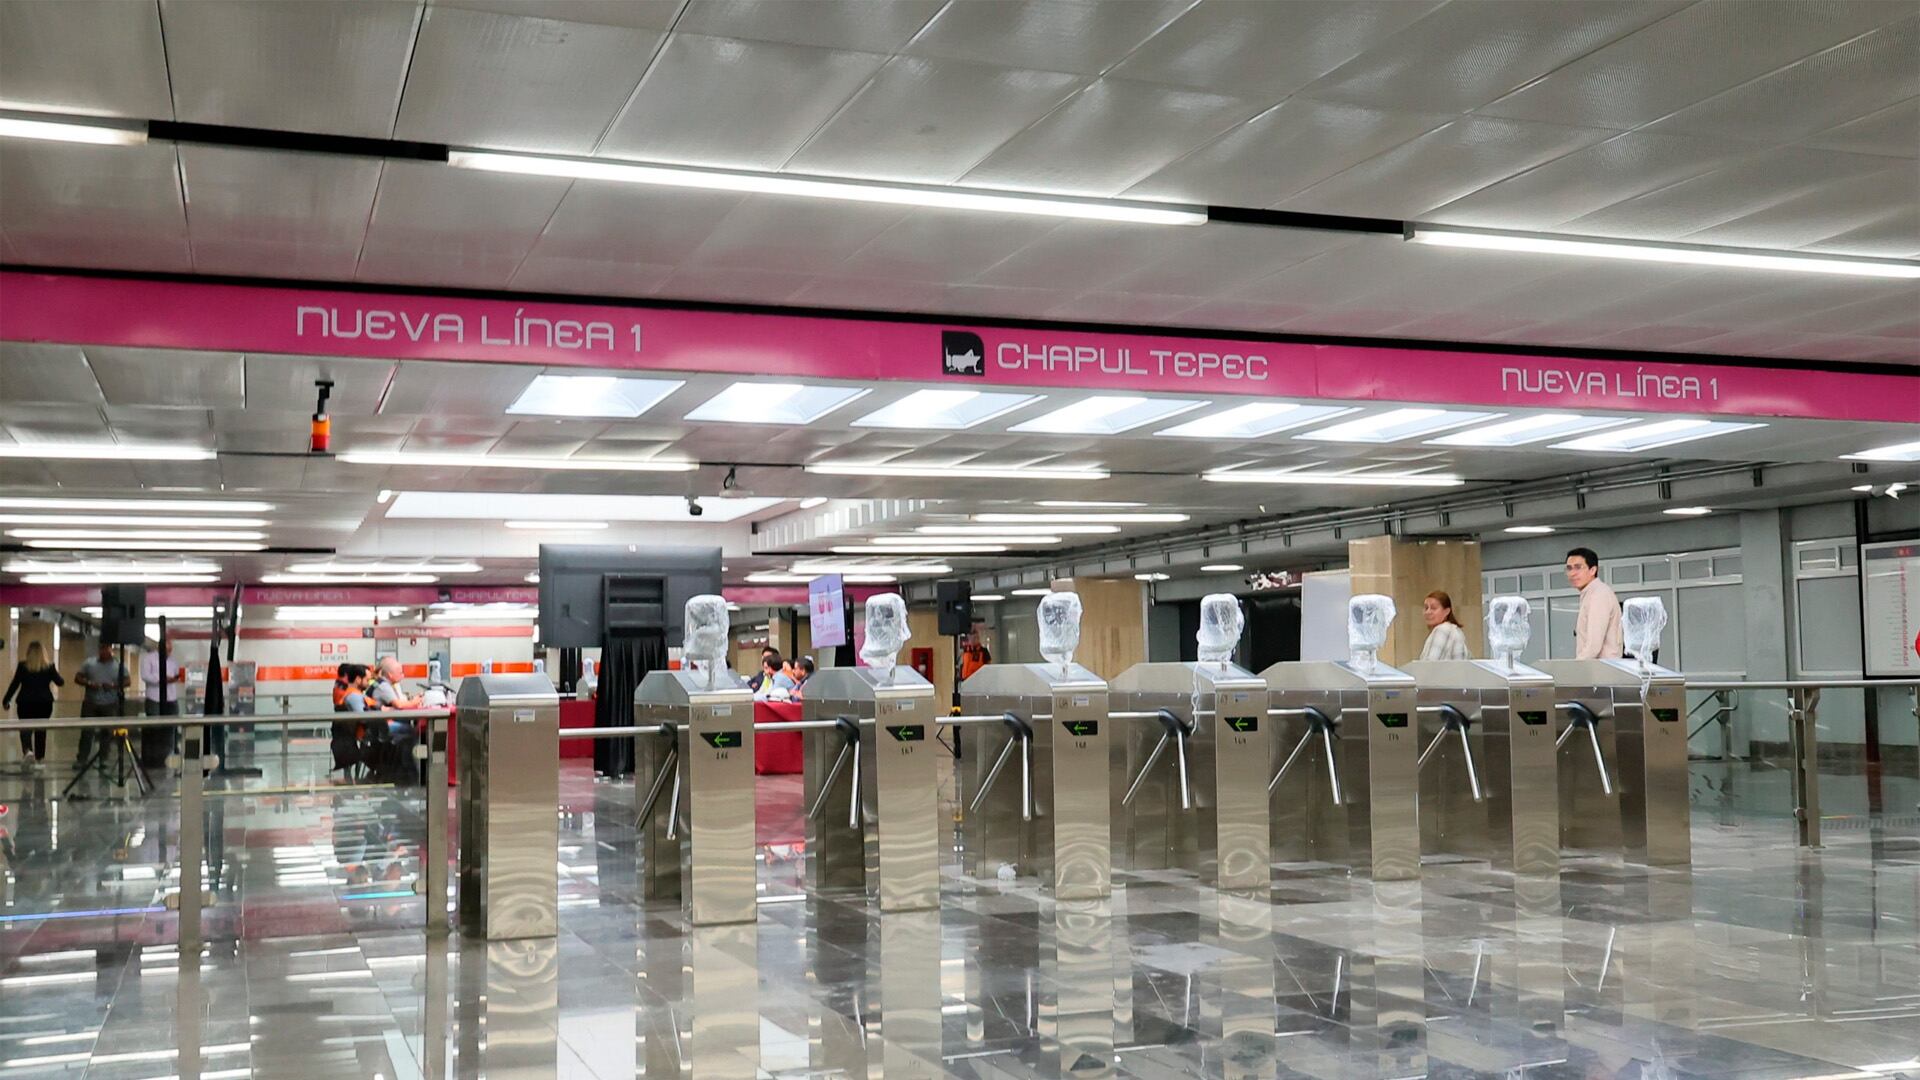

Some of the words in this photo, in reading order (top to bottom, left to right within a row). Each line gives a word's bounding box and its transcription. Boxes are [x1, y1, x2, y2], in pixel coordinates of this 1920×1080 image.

[296, 305, 464, 344] NUEVA
[480, 307, 615, 351] LÍNEA
[629, 323, 642, 353] 1
[996, 342, 1269, 381] CHAPULTEPEC
[1501, 366, 1606, 396] NUEVA
[1615, 366, 1701, 400] LÍNEA
[1709, 377, 1718, 400] 1
